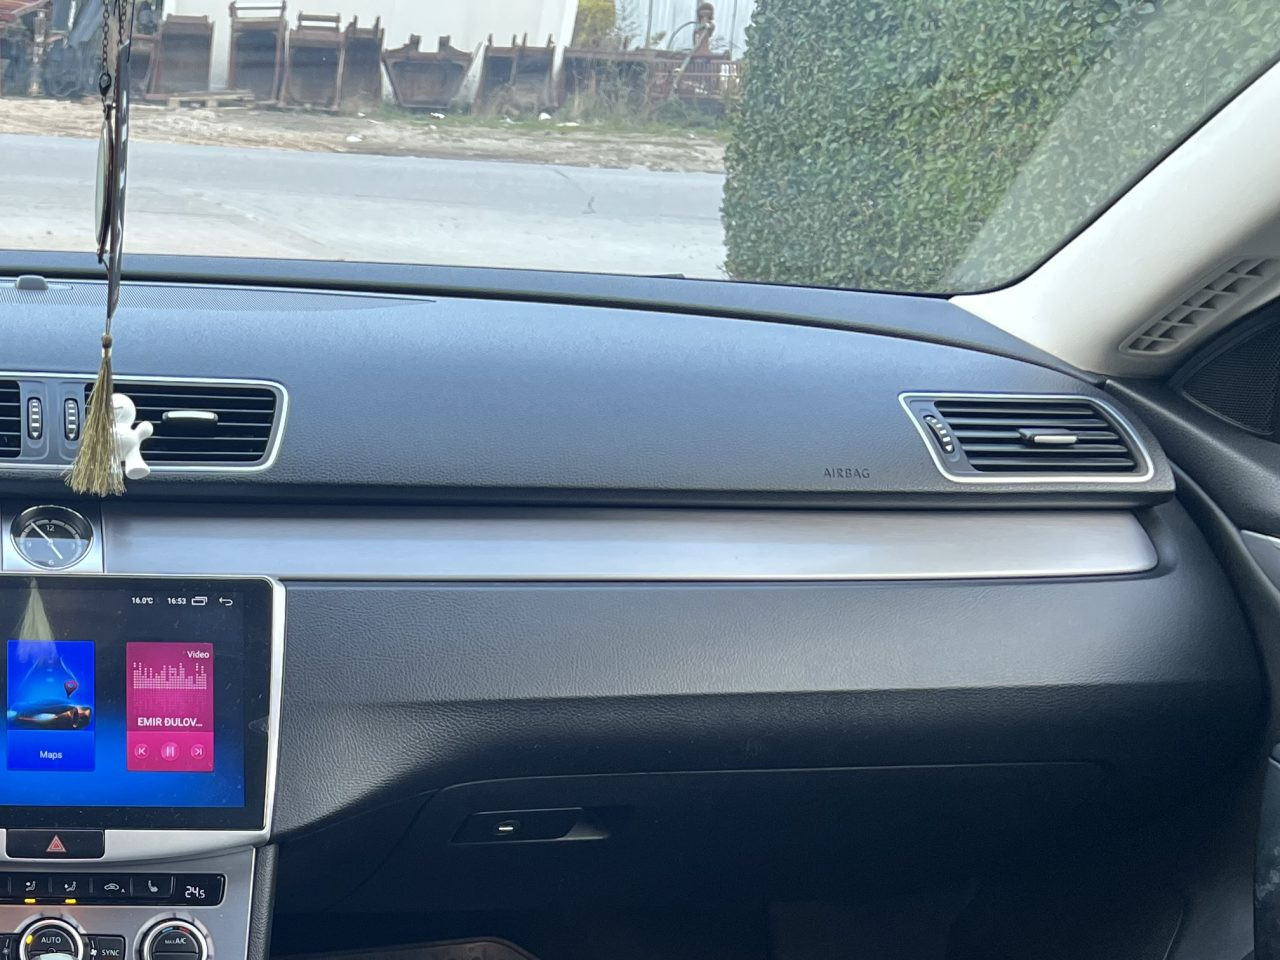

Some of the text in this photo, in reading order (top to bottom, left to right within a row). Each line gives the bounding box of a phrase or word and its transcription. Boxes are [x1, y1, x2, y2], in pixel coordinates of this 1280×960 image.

[823, 467, 870, 479] AIRBAG
[46, 524, 55, 532] 12
[167, 597, 187, 605] 16:53
[187, 650, 210, 659] Video
[138, 717, 162, 726] EMIR
[40, 750, 63, 760] Maps
[41, 936, 61, 944] AUTO
[175, 937, 187, 945] A/C
